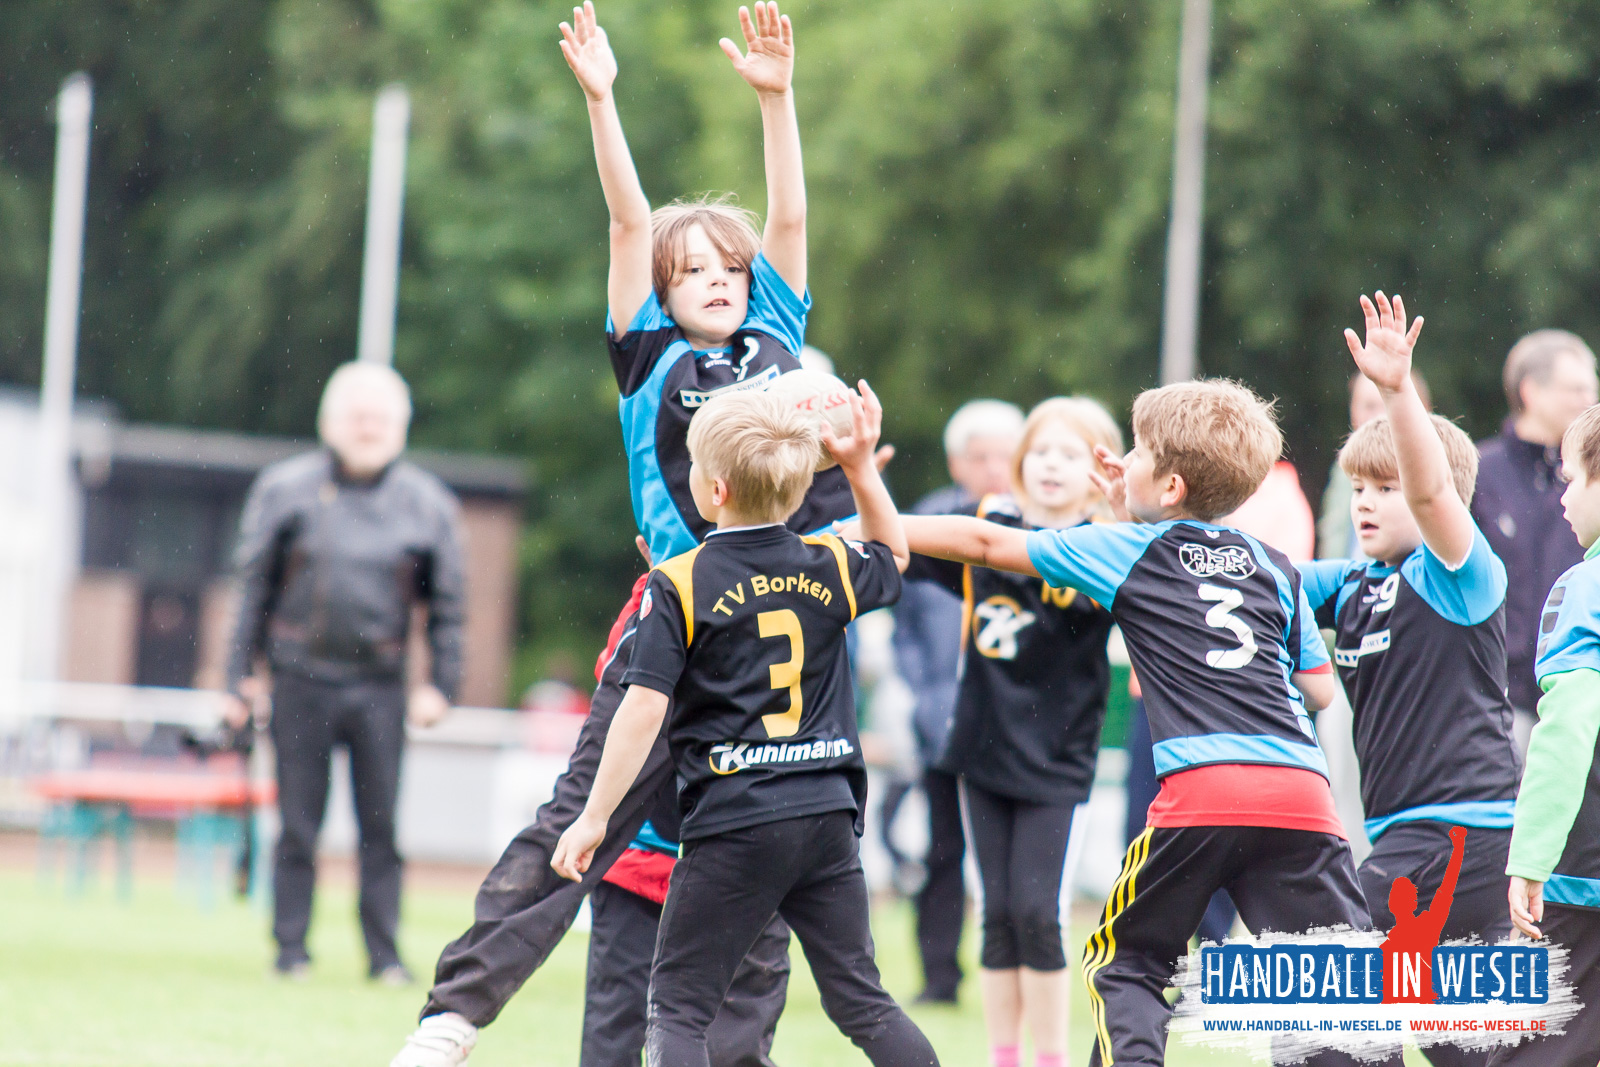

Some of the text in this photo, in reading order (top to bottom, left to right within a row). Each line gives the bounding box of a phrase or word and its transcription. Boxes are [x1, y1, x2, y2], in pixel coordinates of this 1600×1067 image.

[712, 572, 832, 616] TV Borken
[1198, 583, 1258, 669] 3
[757, 609, 804, 738] 3
